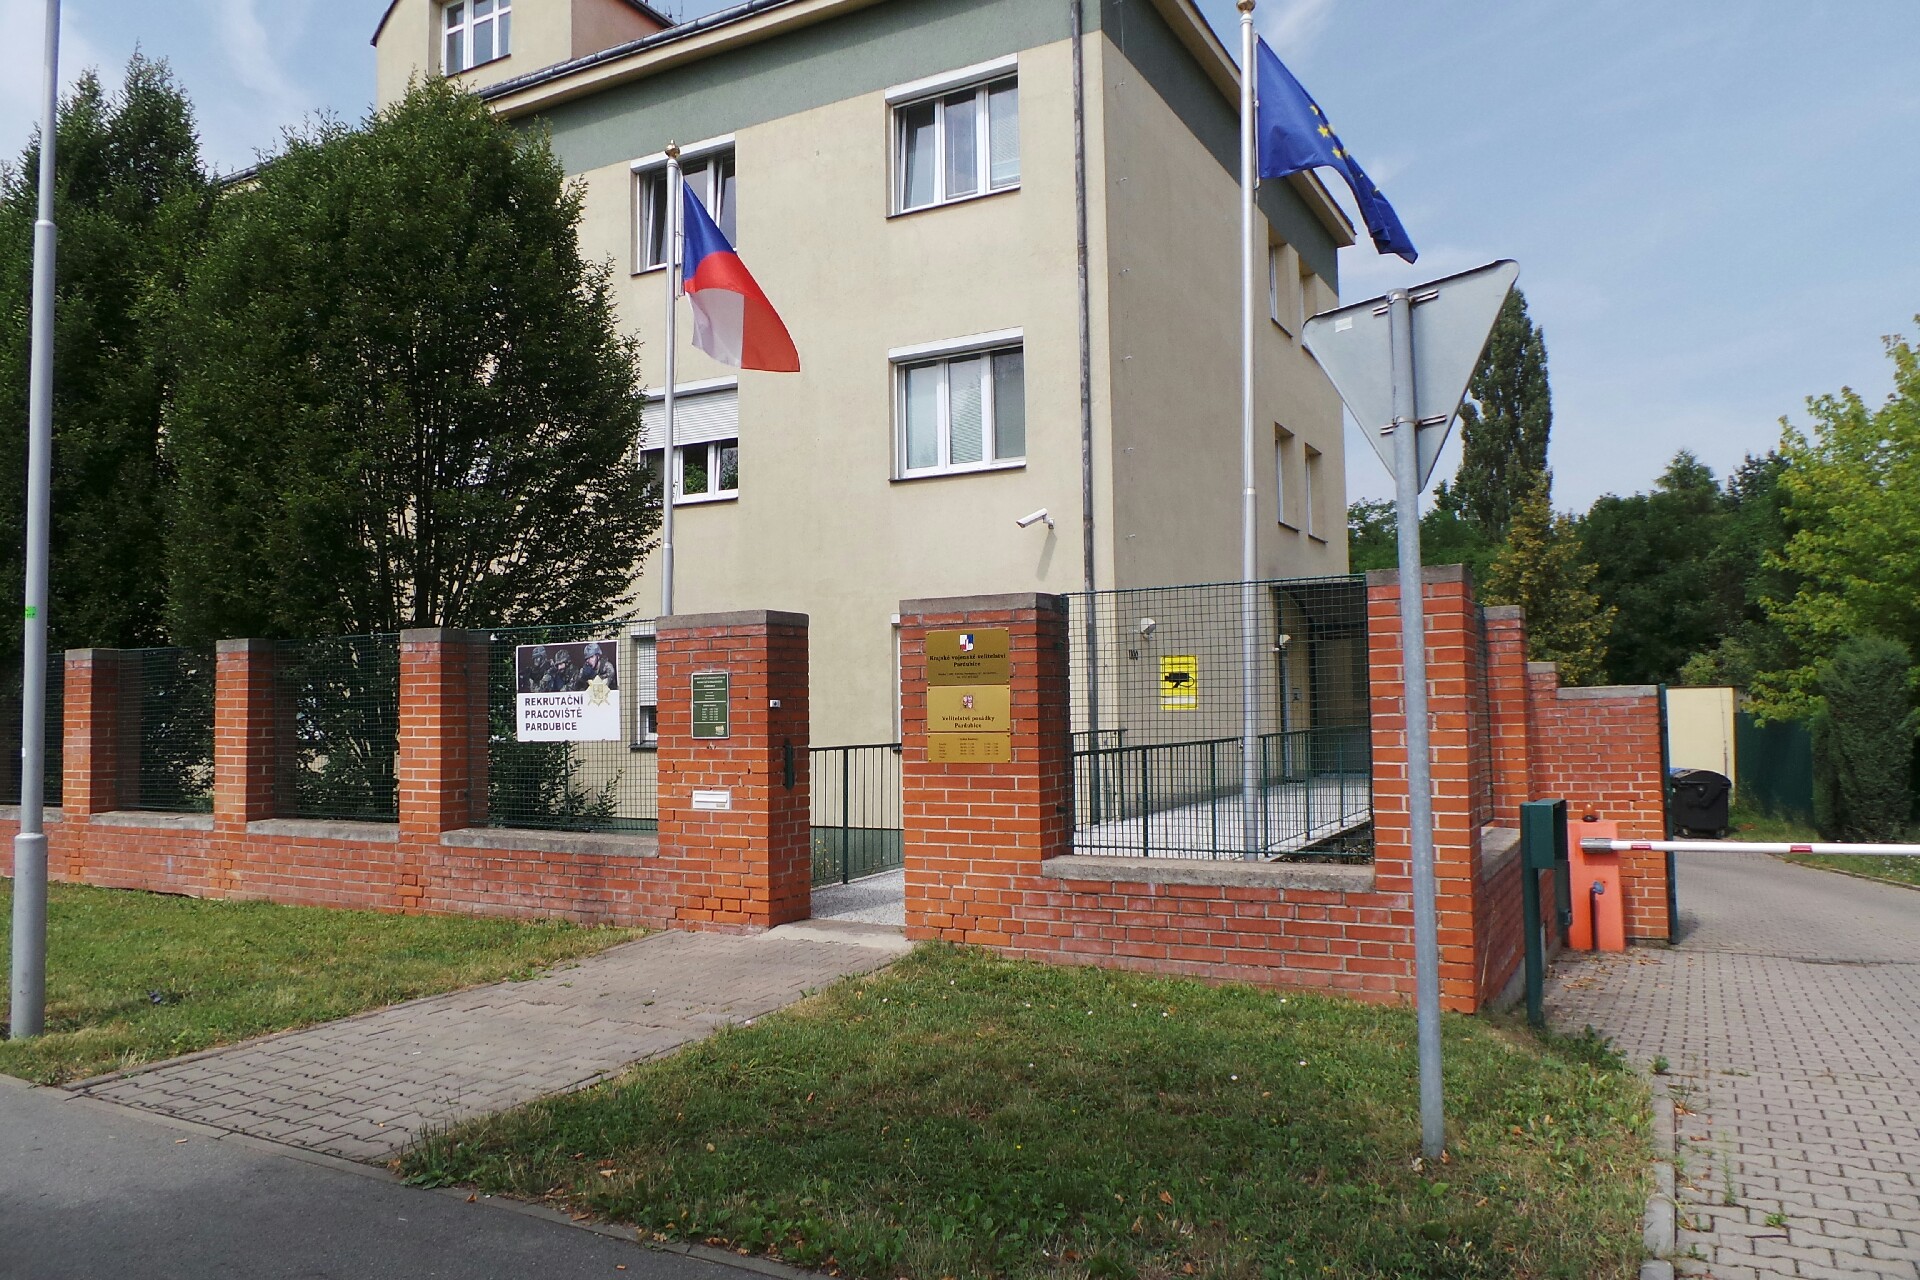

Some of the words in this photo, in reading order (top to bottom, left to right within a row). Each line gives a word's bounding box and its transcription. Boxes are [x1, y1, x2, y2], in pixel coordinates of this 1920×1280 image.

[525, 694, 583, 706] REKRUTAČNÍ
[525, 707, 582, 718] PRACOVIŠTĚ
[525, 722, 577, 731] PARDUBICE
